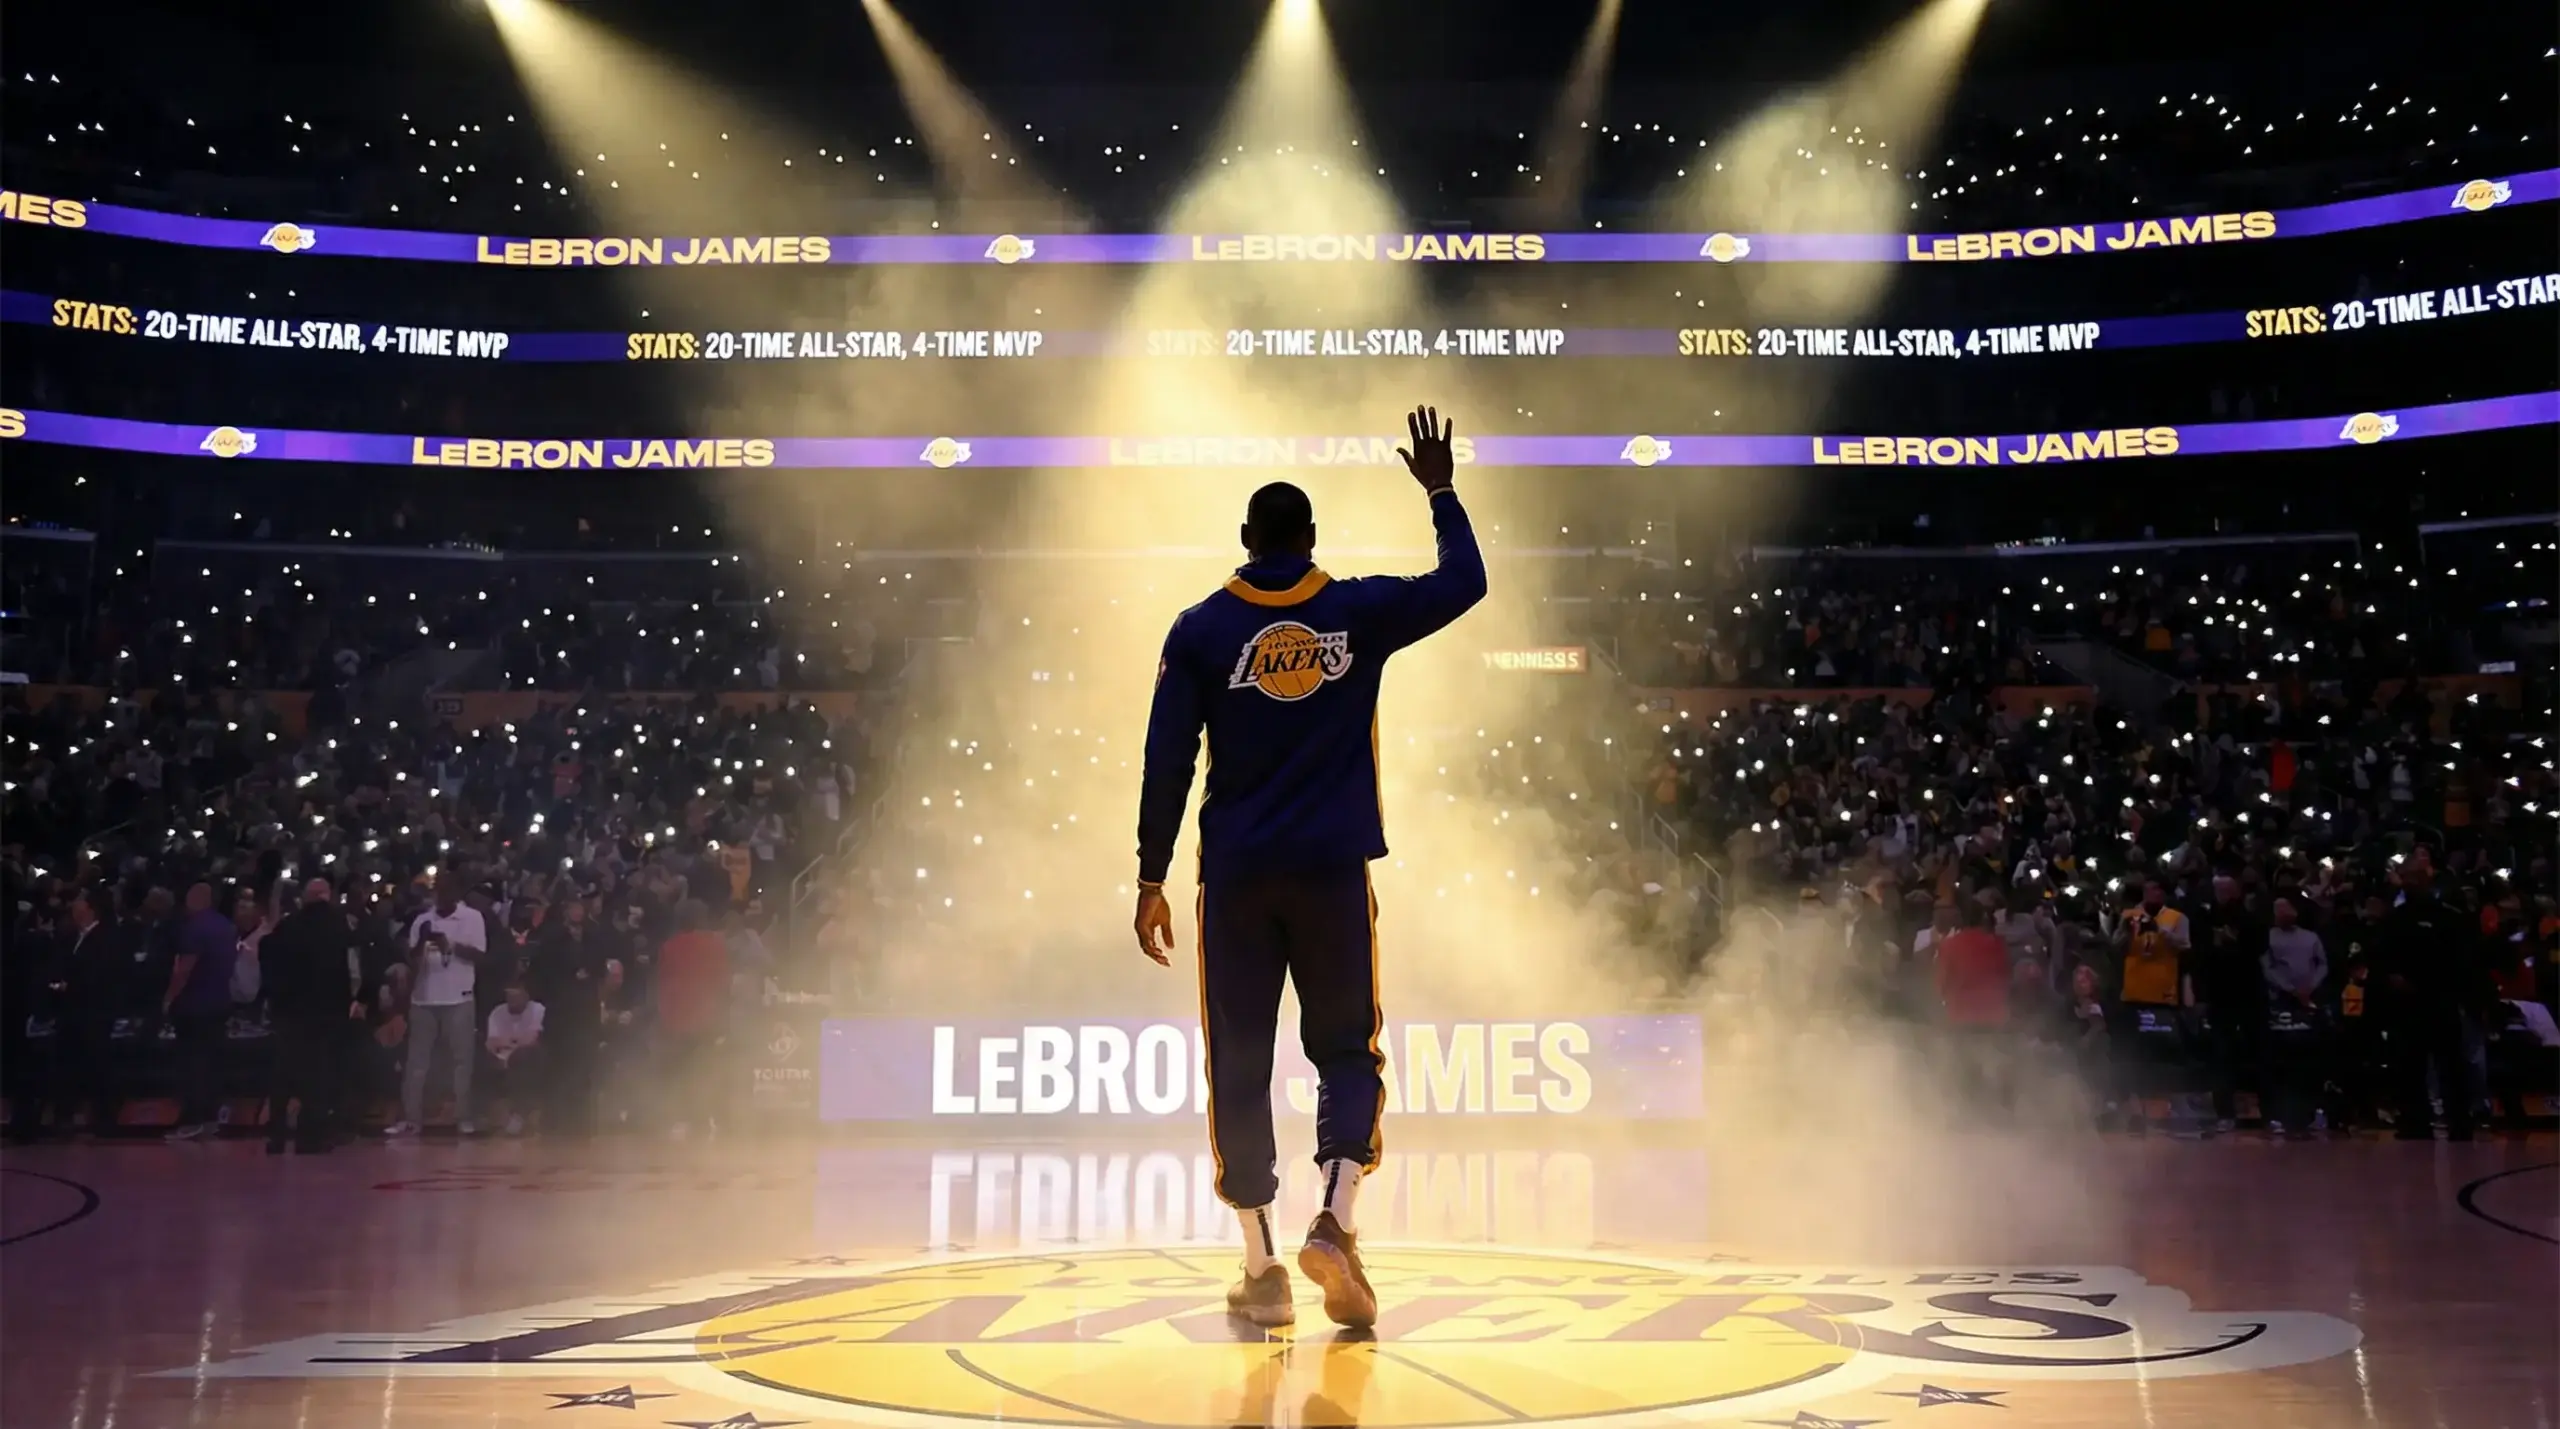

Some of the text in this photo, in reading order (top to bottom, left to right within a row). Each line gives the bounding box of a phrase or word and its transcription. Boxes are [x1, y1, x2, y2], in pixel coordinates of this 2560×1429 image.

[476, 236, 831, 265] LeBRON JAMES
[1192, 234, 1545, 261] LeBRON JAMES
[1907, 211, 2276, 261] LeBRON JAMES
[2246, 273, 2560, 338] STATS: 20-TIME ALL-STAR
[52, 299, 508, 359] STATS: 20-TIME ALL-STAR, 4-TIME MVP
[627, 331, 1042, 361] STATS: 20-TIME ALL-STAR, 4-TIME MVP
[1148, 328, 1564, 359] STATS: 20-TIME ALL-STAR, 4-TIME MVP
[1679, 322, 2100, 360] STATS: 20-TIME ALL-STAR, 4-TIME MVP
[413, 437, 775, 469] LeBRON JAMES
[1109, 437, 1476, 466] LeBRON JAMS
[1812, 426, 2179, 465] LeBRON JAMES
[1233, 644, 1350, 684] LAKERS
